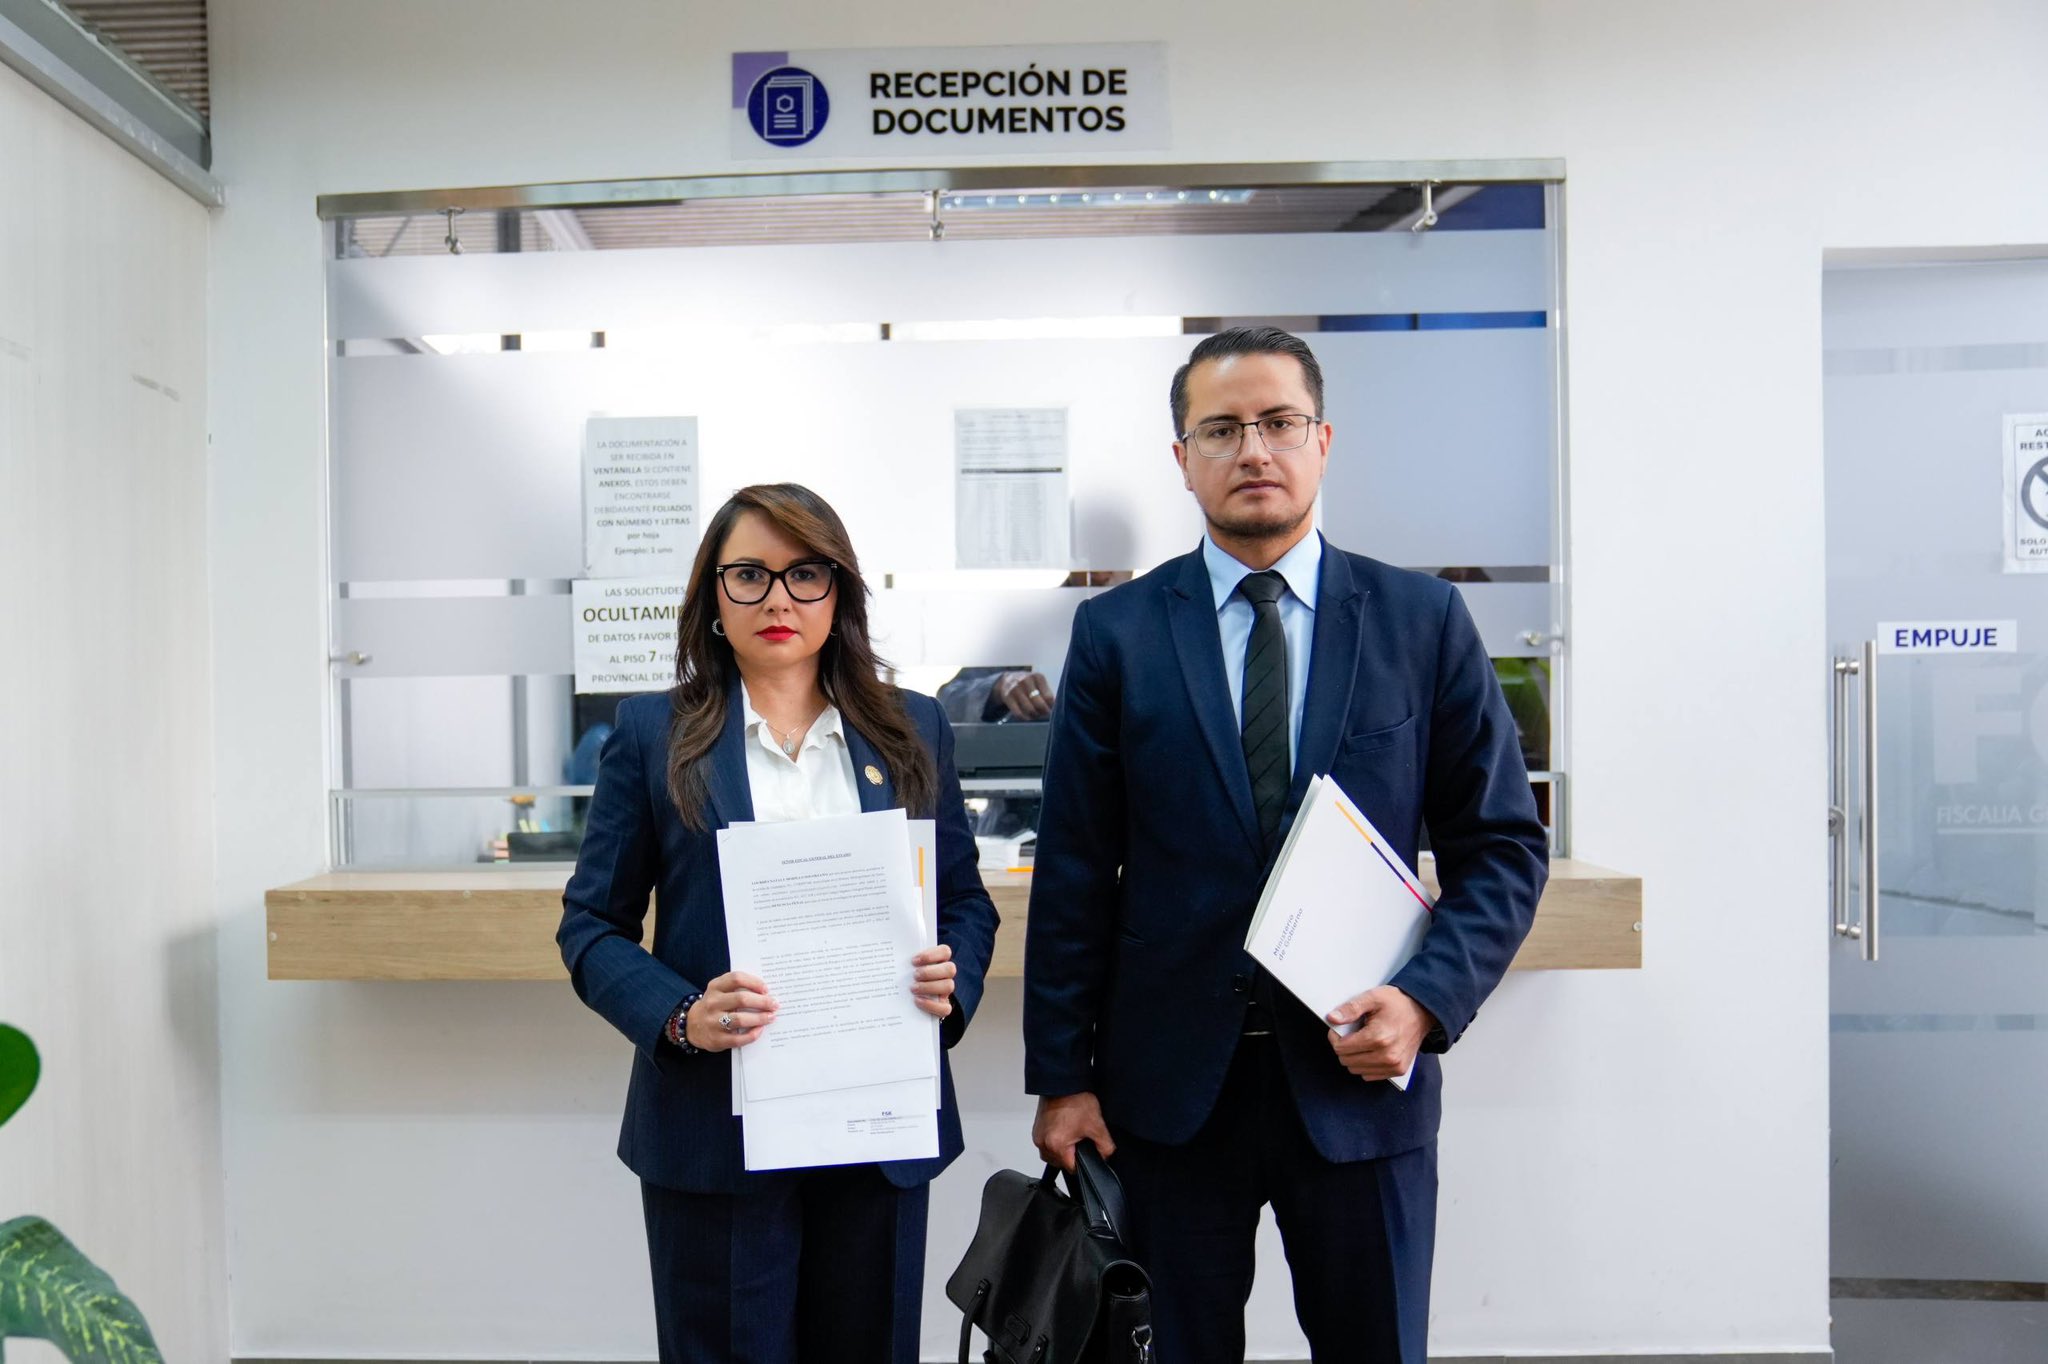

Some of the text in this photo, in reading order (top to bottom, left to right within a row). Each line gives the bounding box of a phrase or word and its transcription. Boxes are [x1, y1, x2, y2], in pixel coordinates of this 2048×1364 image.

[869, 63, 1128, 99] RECEPCIÓN DE
[873, 105, 1126, 135] DOCUMENTOS
[593, 466, 642, 475] VENTANILLA
[652, 504, 693, 513] FOLIADOS
[596, 519, 614, 527] CON
[2020, 538, 2047, 546] SOLO
[605, 586, 685, 597] LAS SOLICITUDES
[588, 634, 600, 643] DE
[603, 633, 636, 643] DATOS
[639, 632, 671, 641] FAVOR
[1895, 628, 1998, 648] EMPUJE
[609, 655, 621, 664] AL
[623, 654, 646, 663] PISO
[648, 650, 657, 662] 7
[592, 672, 649, 683] PROVINCIAL
[652, 672, 664, 681] DE
[1937, 805, 2022, 824] FISCALIA
[1273, 914, 1294, 956] Ministerio
[1279, 908, 1303, 961] de Gobierno
